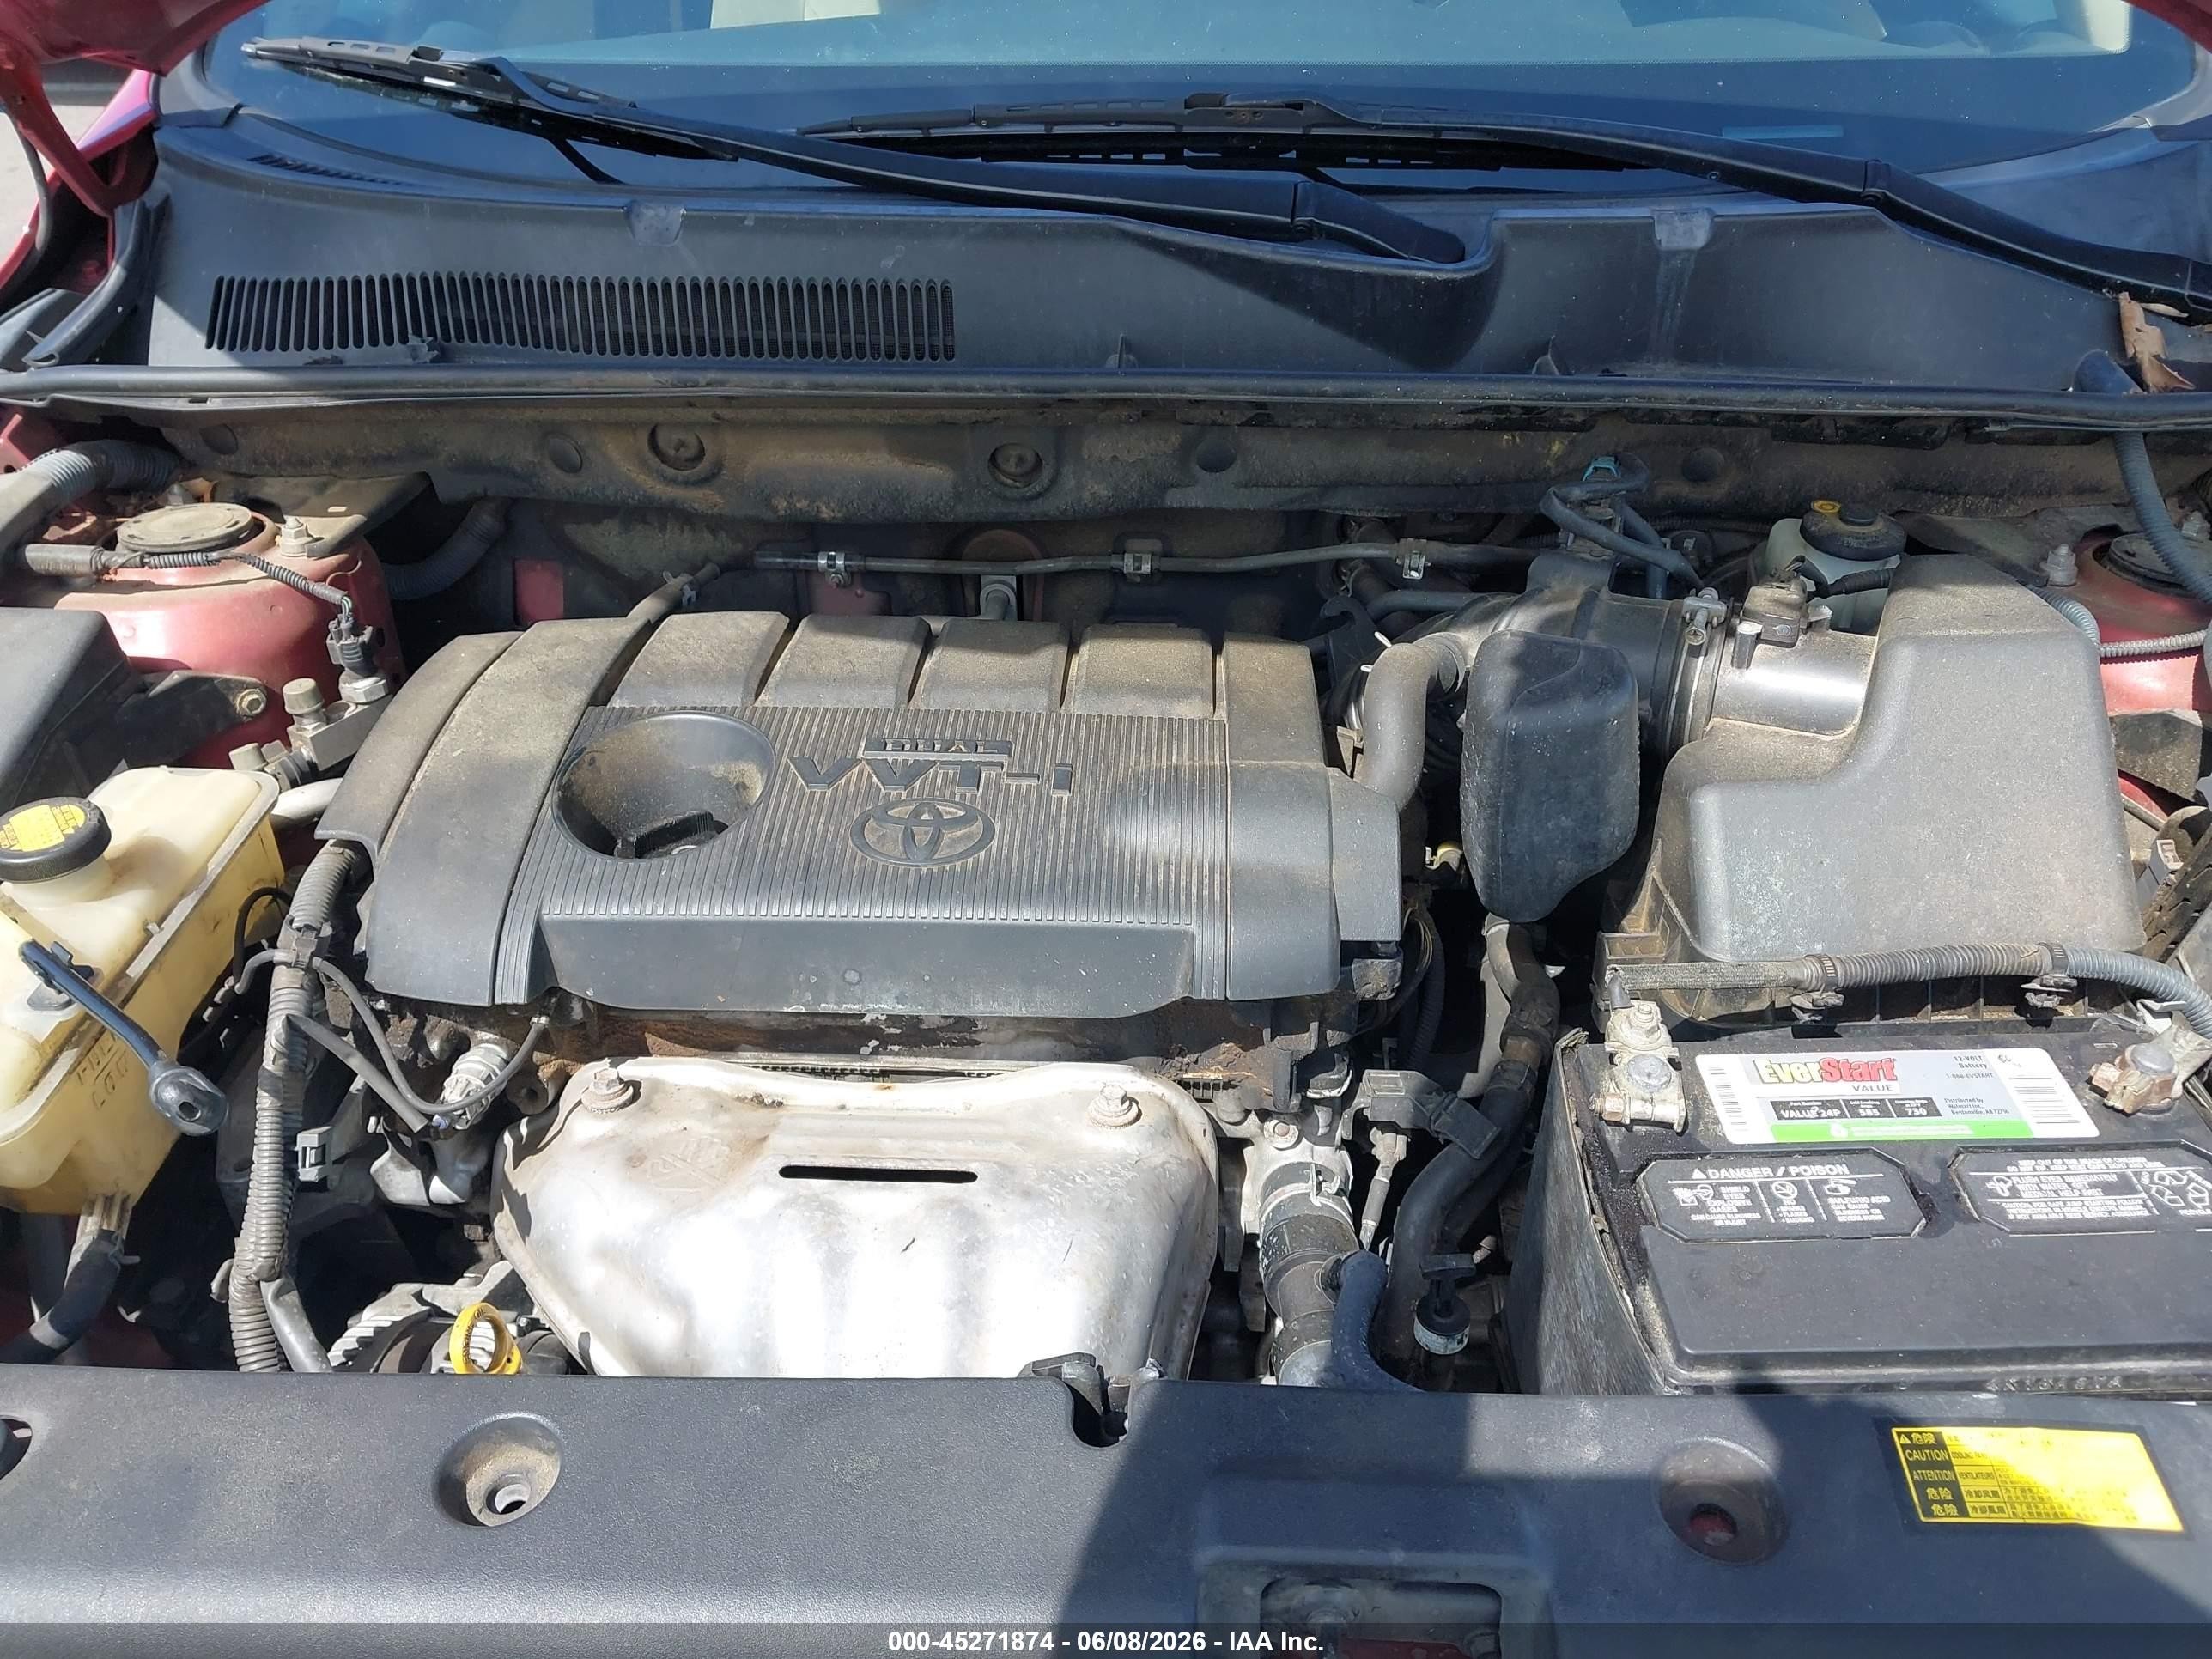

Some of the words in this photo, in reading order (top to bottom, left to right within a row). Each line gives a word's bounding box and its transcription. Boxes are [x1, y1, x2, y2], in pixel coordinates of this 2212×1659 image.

[884, 738, 999, 754] DUAL
[1753, 1057, 1898, 1084] EverStart
[1905, 1107, 1928, 1115] 730
[1707, 1167, 1774, 1180] DANGER
[1789, 1164, 1850, 1176] POISON
[2039, 1175, 2064, 1183] EYES
[1905, 1449, 1950, 1462] CAUTION
[1912, 1469, 1957, 1481] ATTENTION
